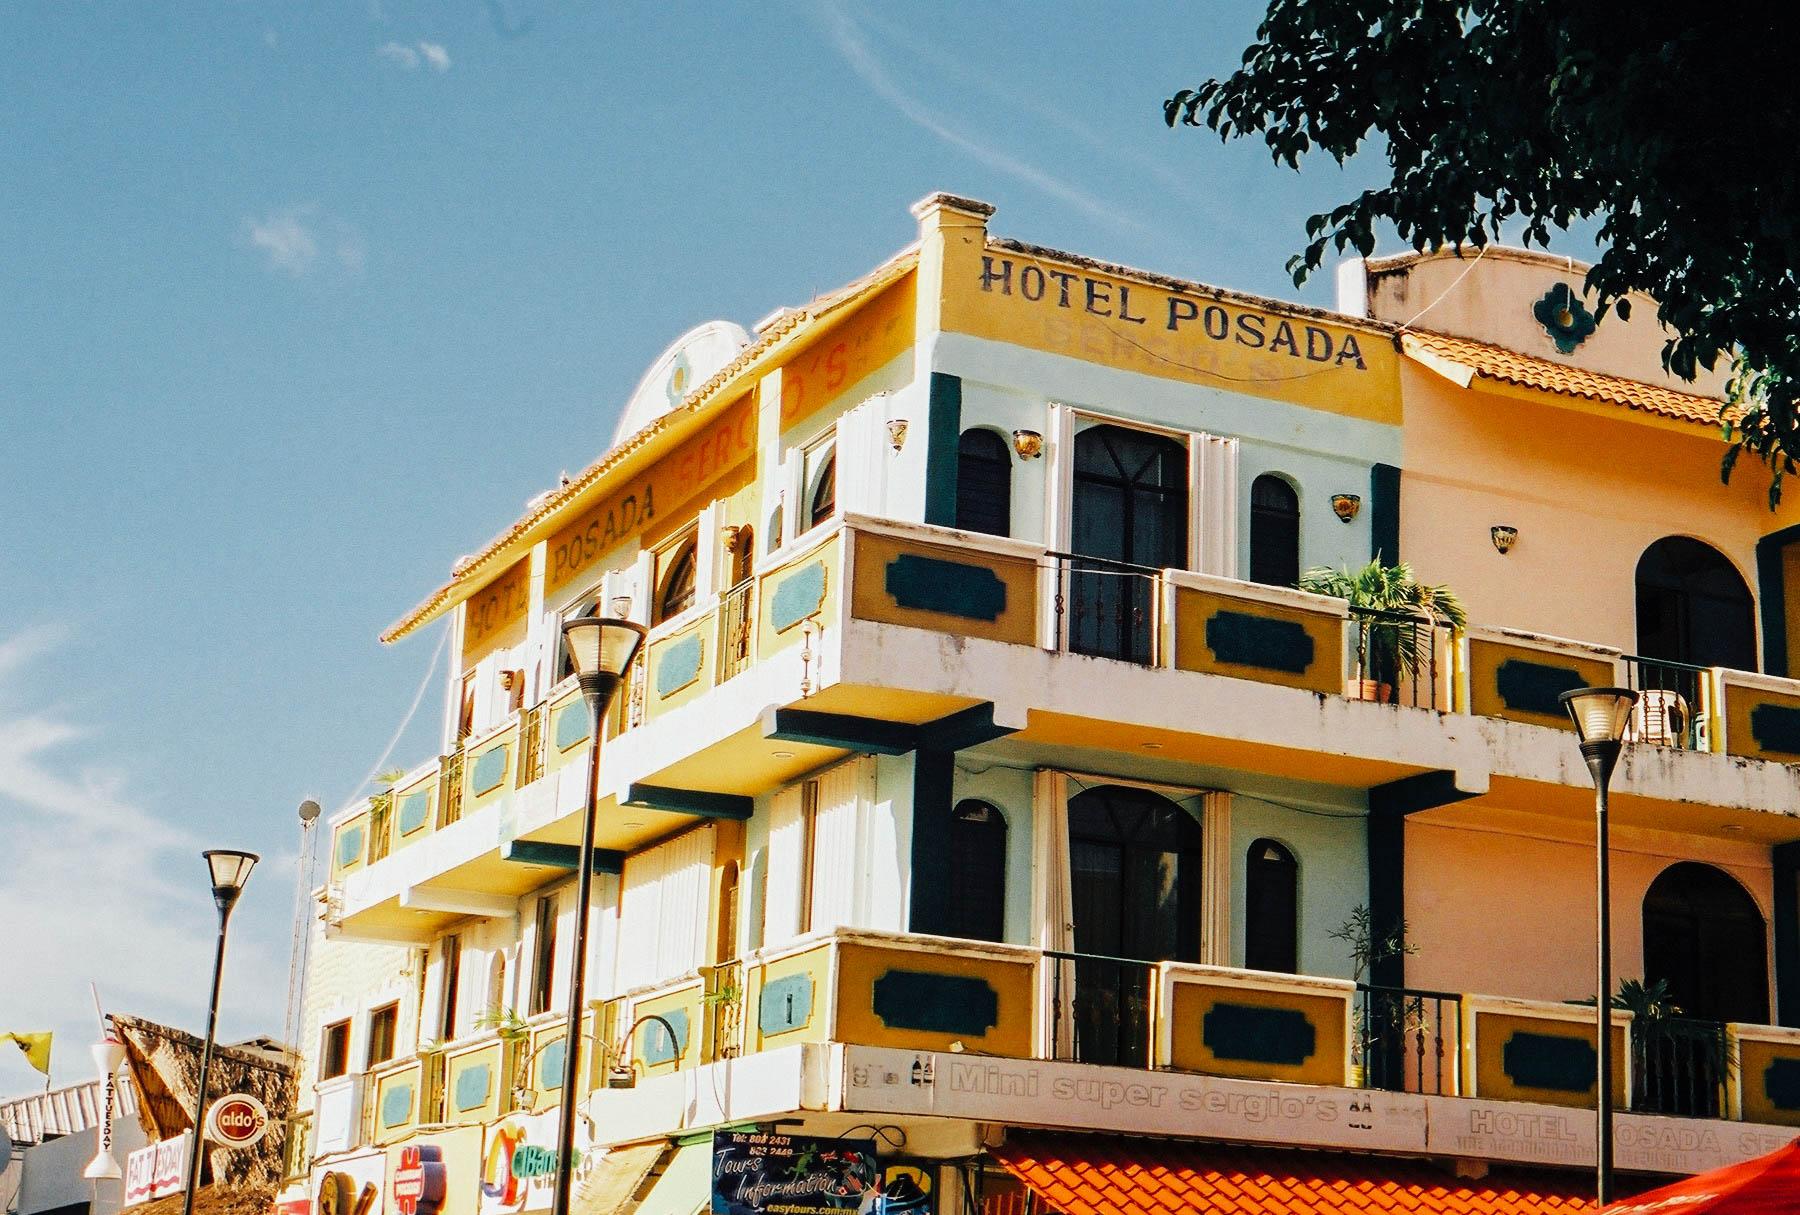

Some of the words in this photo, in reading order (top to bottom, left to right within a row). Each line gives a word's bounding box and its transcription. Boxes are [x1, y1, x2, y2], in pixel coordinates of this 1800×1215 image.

[980, 255, 1146, 325] HOTEL
[1166, 296, 1368, 371] POSADA
[552, 484, 655, 585] POSADA
[951, 1062, 1038, 1098] Mini
[1052, 1077, 1169, 1110] super
[1179, 1087, 1338, 1122] sergio's
[221, 1110, 265, 1128] aldo's
[1470, 1109, 1577, 1142] HOTEL
[1615, 1123, 1722, 1153] OSADA
[716, 1147, 763, 1178] Tours
